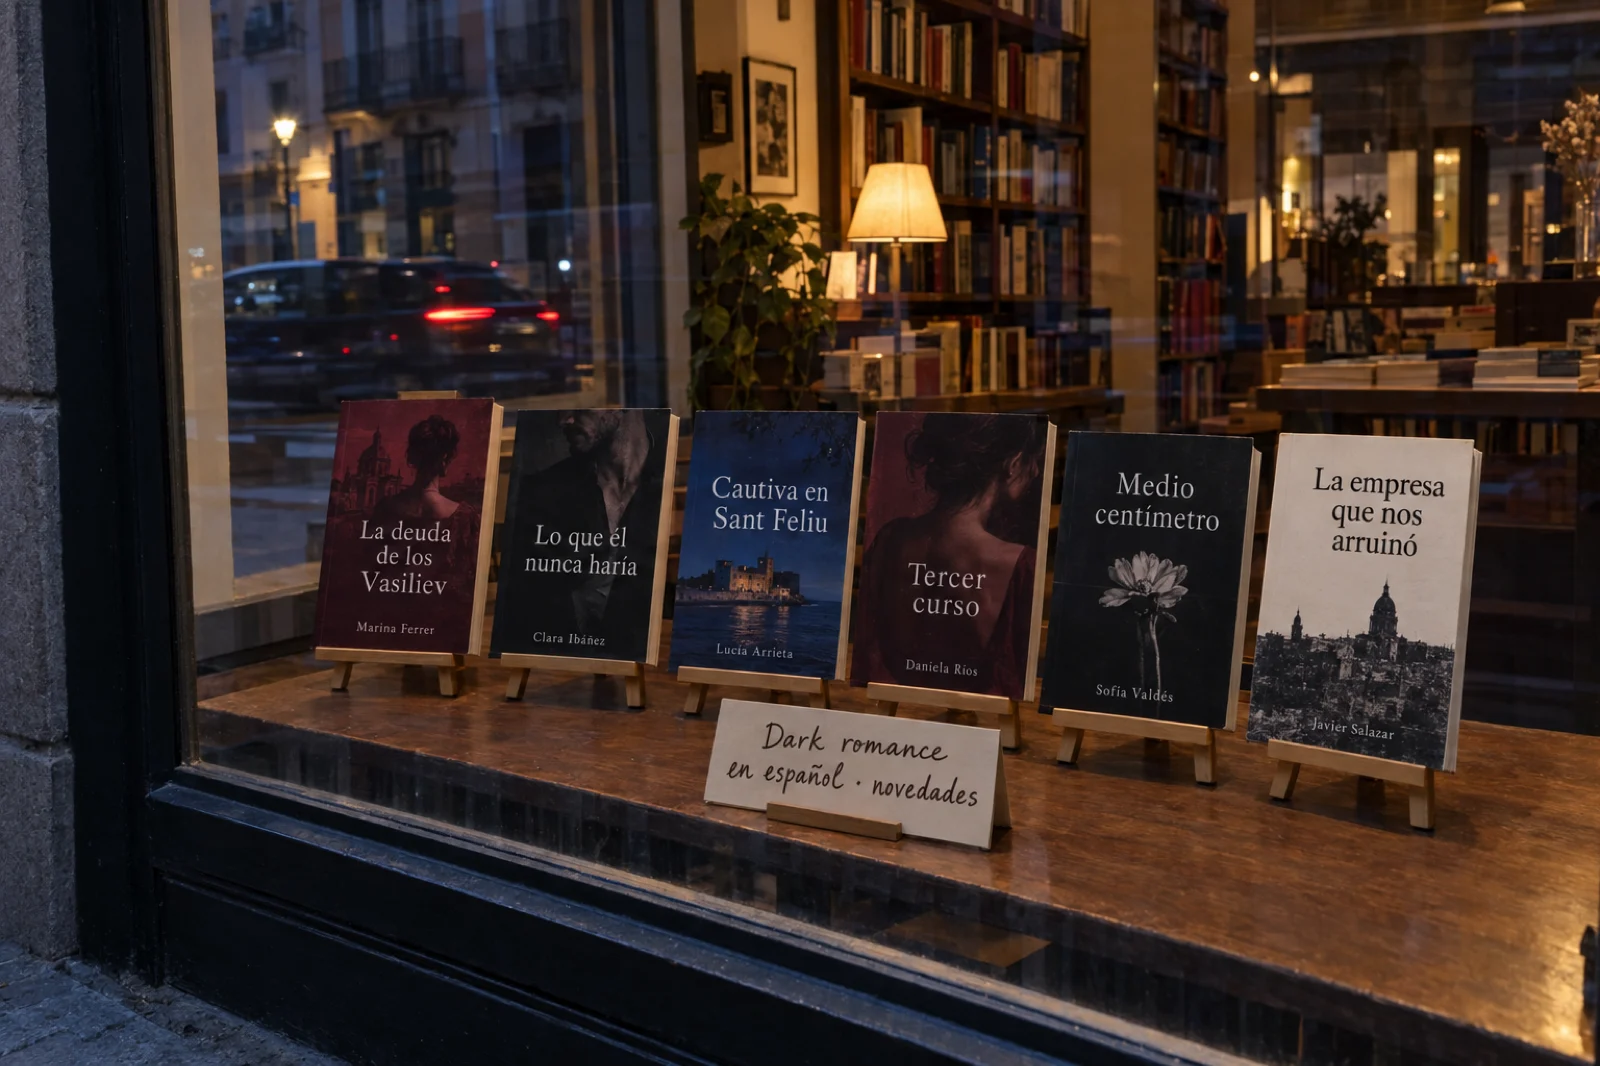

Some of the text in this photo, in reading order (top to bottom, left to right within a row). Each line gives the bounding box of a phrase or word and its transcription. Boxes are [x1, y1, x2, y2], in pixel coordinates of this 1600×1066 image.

[712, 475, 828, 502] Cautiva en
[1116, 472, 1194, 499] Medio
[1313, 467, 1445, 501] La empresa
[713, 506, 827, 532] Sant Feliu
[1095, 505, 1219, 532] centímetro
[1331, 504, 1423, 529] que nos
[360, 520, 451, 542] La deuda
[535, 524, 627, 552] Lo que él
[377, 546, 432, 566] de los
[1332, 533, 1418, 557] arruinó
[525, 555, 638, 576] nunca haría
[908, 563, 986, 590] Tercer
[362, 571, 447, 595] Vasiliev
[913, 596, 979, 617] curso
[356, 621, 435, 635] Marina Ferrer
[533, 632, 563, 644] Clara
[752, 646, 793, 659] Arrieta
[906, 659, 949, 674] Daniela
[1132, 687, 1174, 703] Valdés
[1312, 717, 1395, 740] Javier Salazar
[762, 722, 948, 761] Dark romance
[726, 760, 753, 780] en
[763, 762, 844, 793] español
[872, 774, 978, 806] novedades
